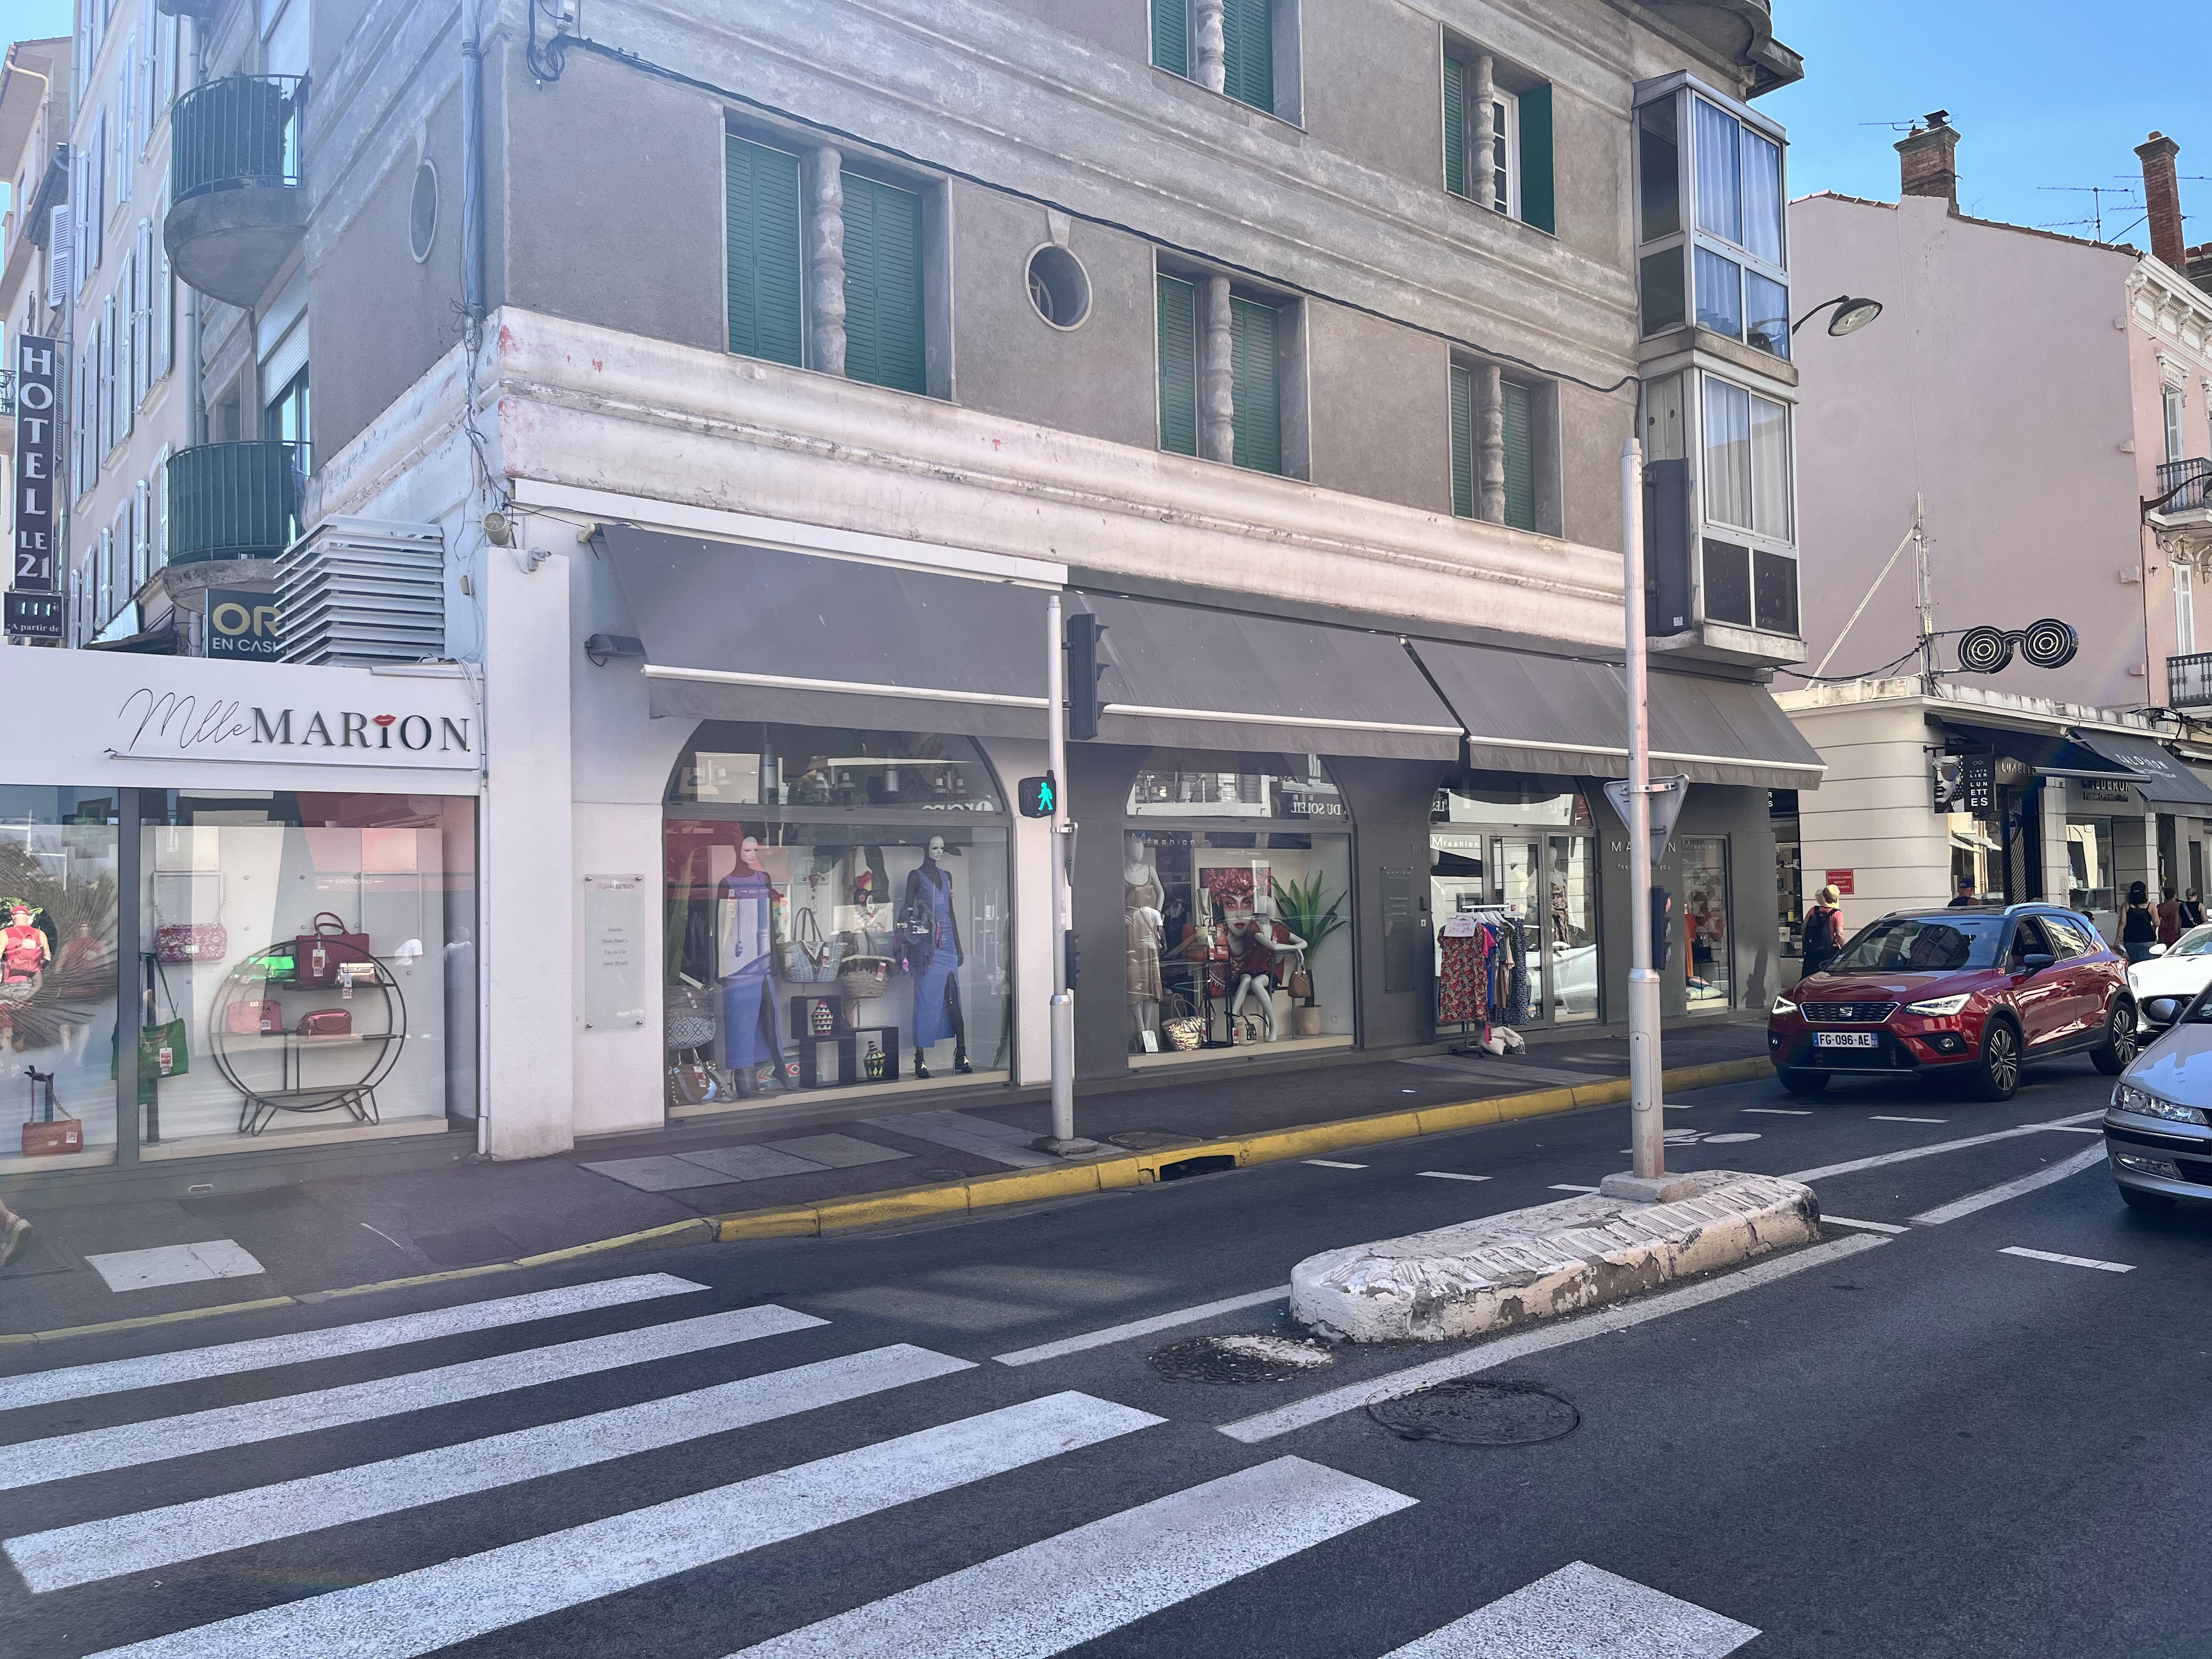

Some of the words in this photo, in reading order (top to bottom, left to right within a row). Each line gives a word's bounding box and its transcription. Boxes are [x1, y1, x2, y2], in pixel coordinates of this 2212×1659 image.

[20, 346, 53, 515] HOTEL
[20, 530, 47, 550] LE
[16, 553, 50, 579] 21
[21, 624, 47, 632] partir
[213, 603, 282, 637] OR
[213, 637, 233, 651] EN
[119, 688, 252, 752] Mlle
[1971, 797, 1988, 806] ES
[1819, 1034, 1870, 1046] FG-096-AE
